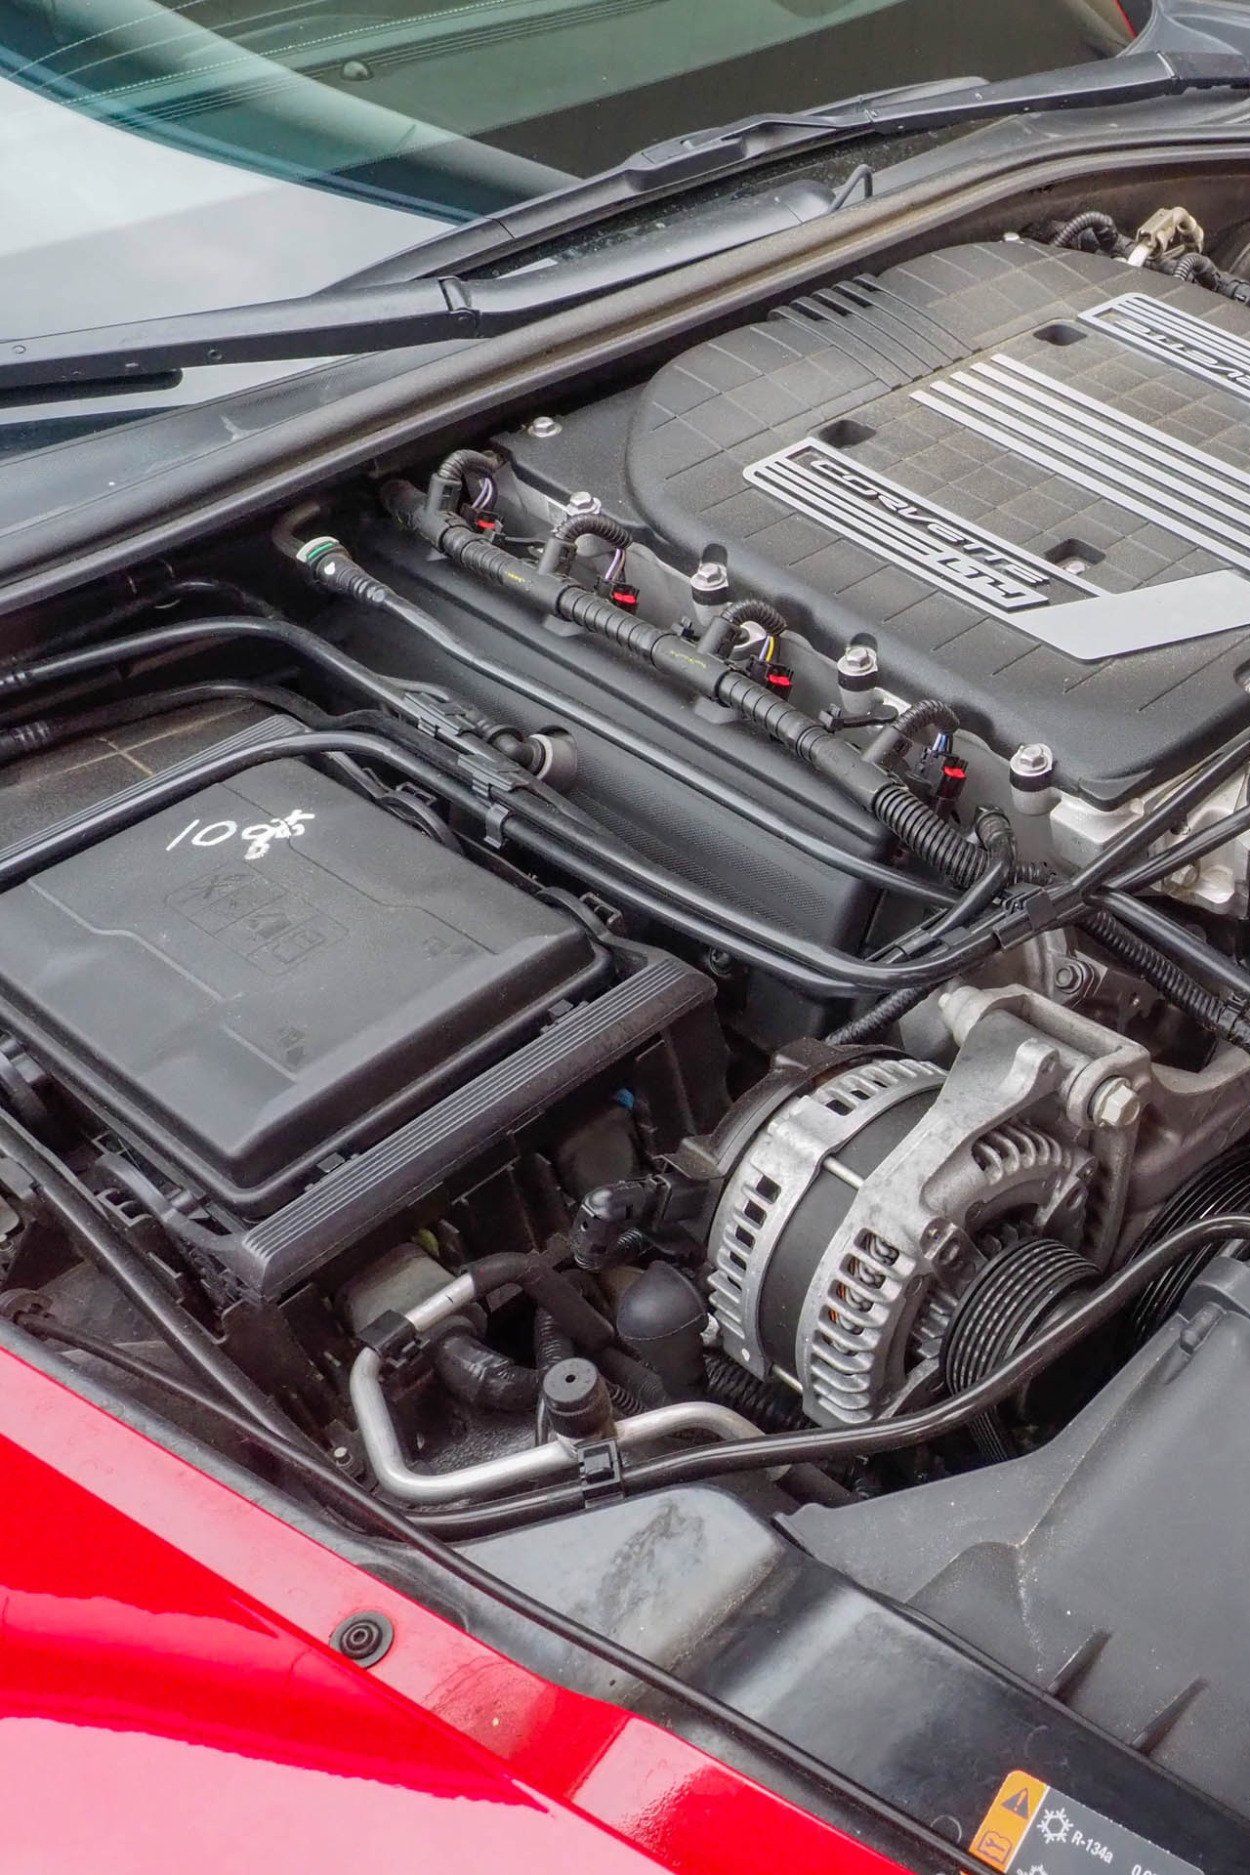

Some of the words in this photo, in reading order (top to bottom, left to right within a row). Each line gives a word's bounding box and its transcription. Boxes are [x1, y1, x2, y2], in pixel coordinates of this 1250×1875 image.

[810, 458, 1050, 587] CORVETTE
[936, 556, 1027, 600] LT4
[1070, 1831, 1115, 1864] R-134a
